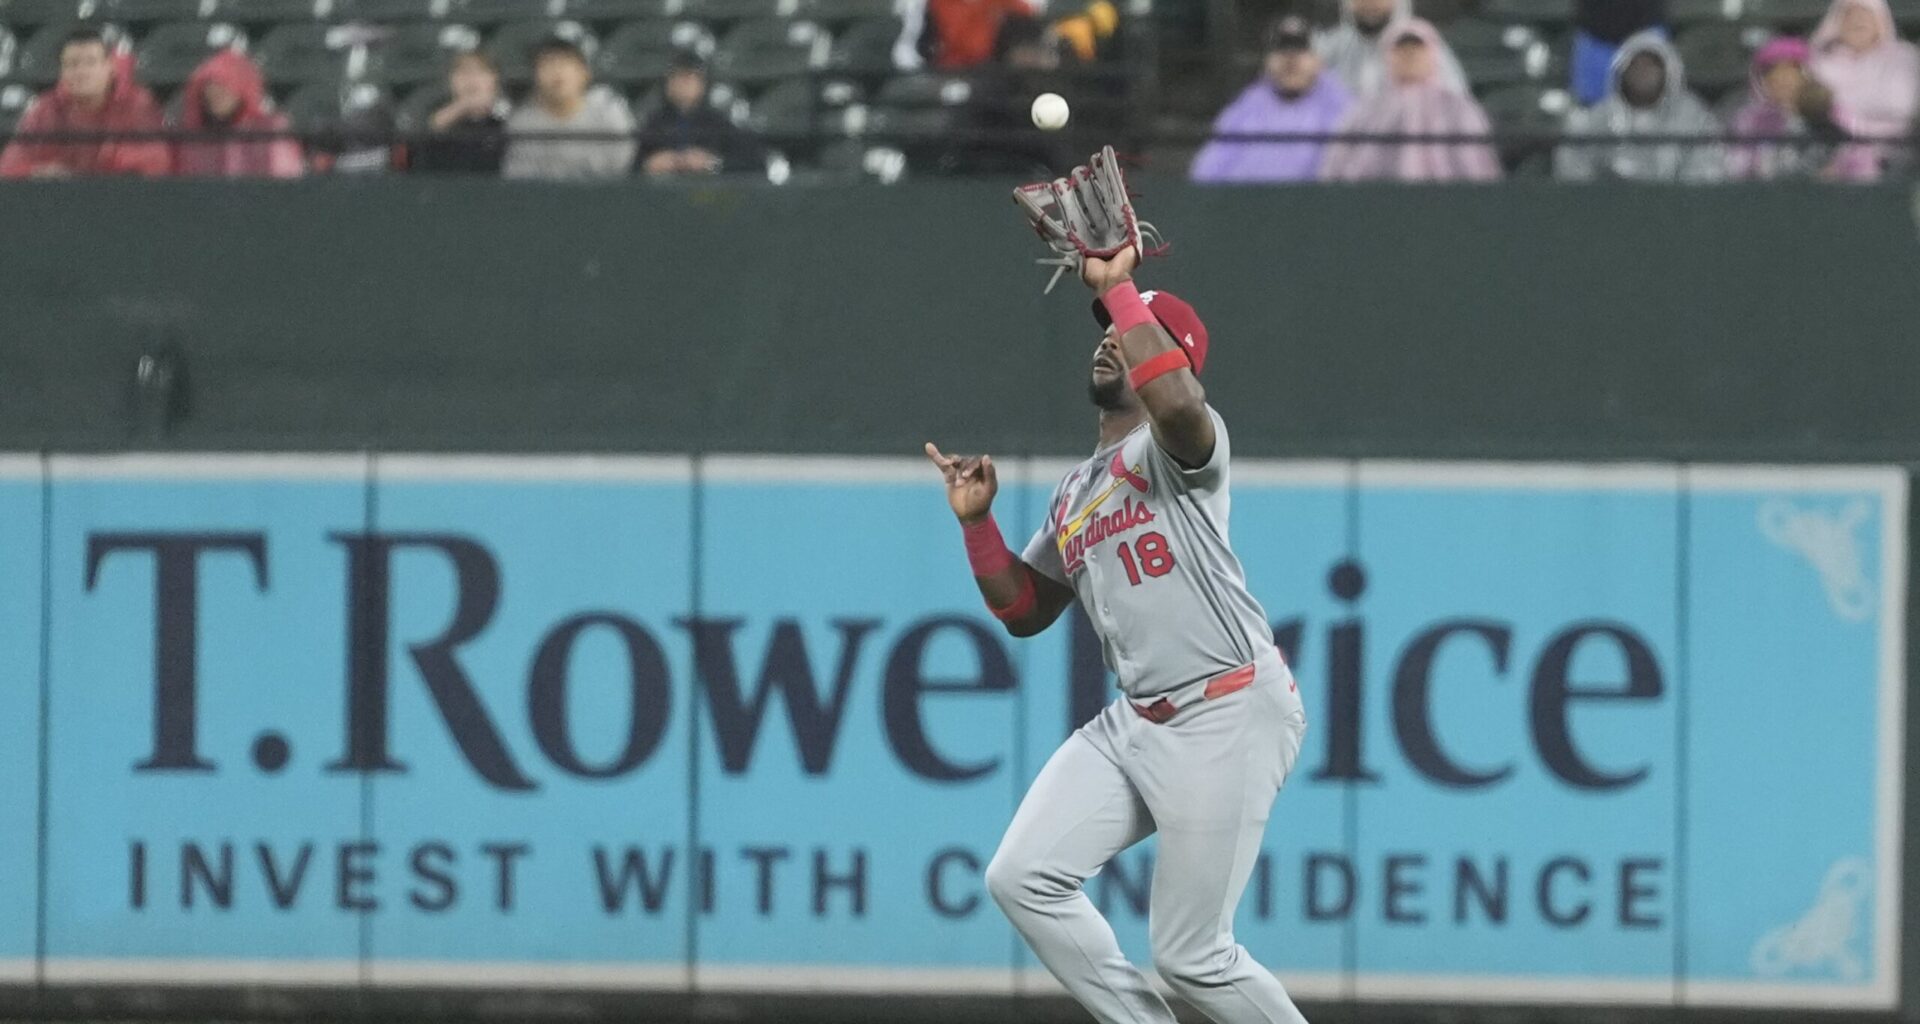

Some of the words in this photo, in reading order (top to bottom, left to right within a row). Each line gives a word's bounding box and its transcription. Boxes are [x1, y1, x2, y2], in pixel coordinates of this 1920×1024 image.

[1117, 531, 1175, 586] 18
[328, 530, 1020, 793] Rowe
[1068, 558, 1666, 793] ice
[129, 841, 526, 915] INVEST
[593, 847, 867, 917] WITH
[926, 850, 1662, 928] CNIDENCE
